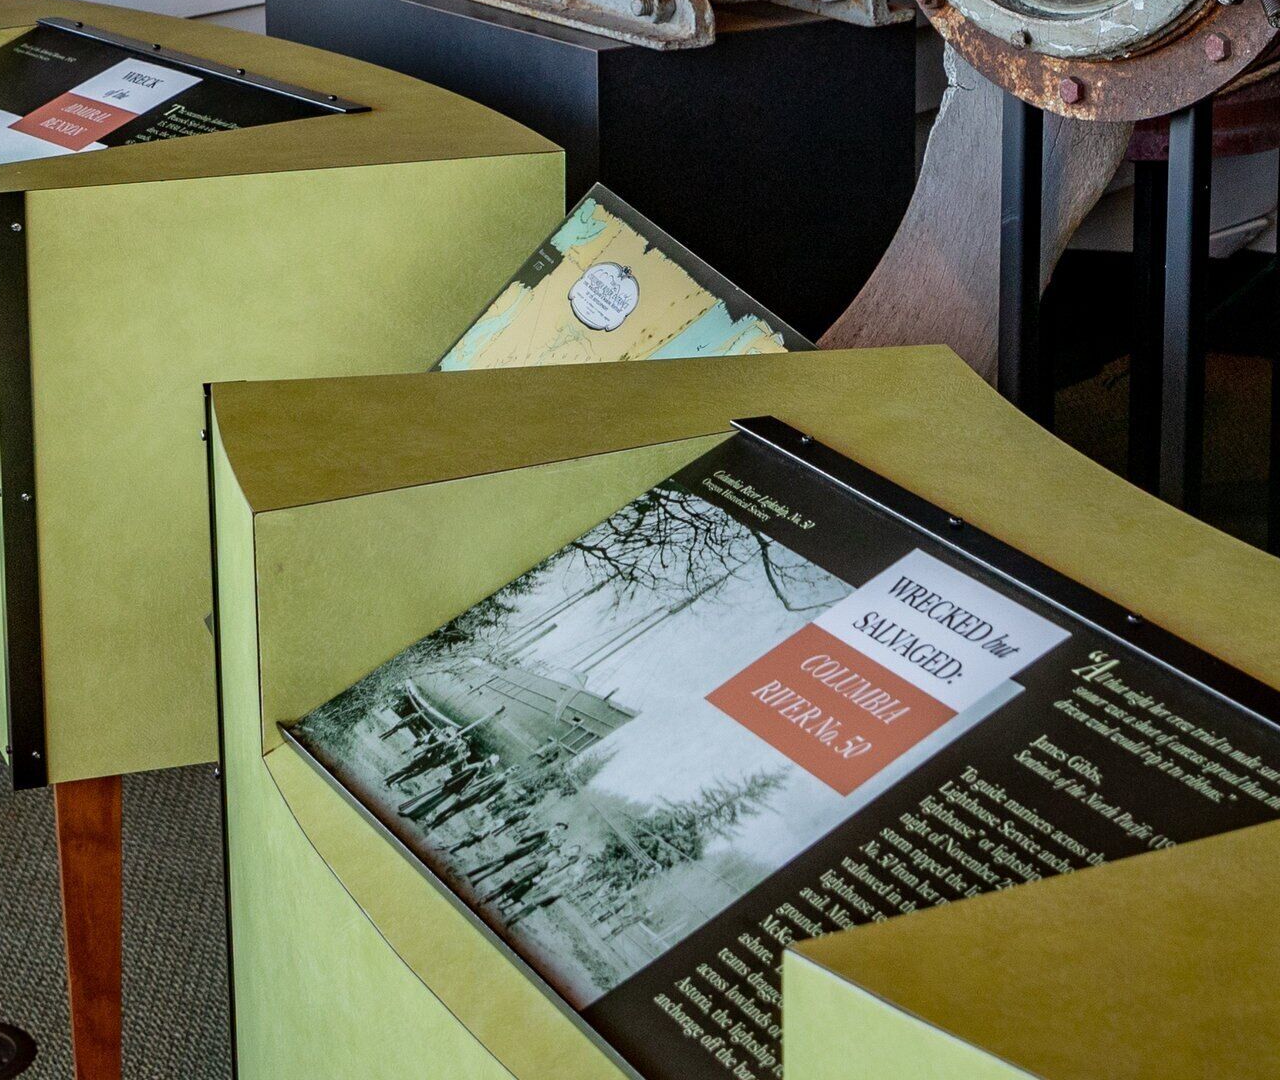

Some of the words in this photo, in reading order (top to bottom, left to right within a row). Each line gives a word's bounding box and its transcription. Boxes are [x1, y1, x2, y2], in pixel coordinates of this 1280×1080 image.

[122, 71, 165, 89] WRECK
[40, 117, 88, 137] BENSON
[61, 103, 112, 124] ADMIRAL
[887, 575, 994, 643] WRECKED
[982, 633, 1020, 659] but
[852, 611, 963, 685] SALVAGED:
[800, 654, 912, 725] COLUMBIA
[751, 679, 822, 733] RIVER
[813, 716, 842, 748] No.
[834, 735, 872, 759] 50
[1029, 734, 1068, 761] James
[1067, 755, 1102, 784] Gibbs,
[1166, 765, 1183, 777] to
[1215, 742, 1232, 753] to
[939, 781, 999, 825] Lighthouse
[997, 820, 1040, 853] Service
[960, 765, 978, 782] To
[970, 779, 1006, 802] guide
[1004, 799, 1053, 833] mariners
[1050, 830, 1087, 856] across
[1052, 777, 1076, 789] of
[1065, 783, 1086, 797] the
[1081, 792, 1120, 818] North
[1113, 812, 1152, 838] Pacific
[879, 827, 912, 852] storm
[909, 848, 951, 877] ripped
[944, 872, 967, 891] the
[899, 812, 930, 836] night
[927, 832, 949, 845] of
[940, 837, 998, 882] November
[978, 838, 995, 850] or
[799, 887, 830, 910] avail.
[820, 869, 873, 914] lighthouse
[841, 857, 893, 894] wallowed
[885, 888, 901, 905] in
[890, 862, 918, 887] from
[915, 879, 939, 900] her
[717, 947, 750, 975] teams
[737, 933, 774, 964] ashore.
[696, 963, 728, 990] across
[725, 985, 771, 1027] lowlands
[654, 993, 703, 1037] anchorage
[700, 1034, 725, 1052] off
[715, 1047, 737, 1067] the
[674, 976, 712, 1013] Astoria,
[710, 1008, 732, 1028] the
[721, 1022, 776, 1066] lightship
